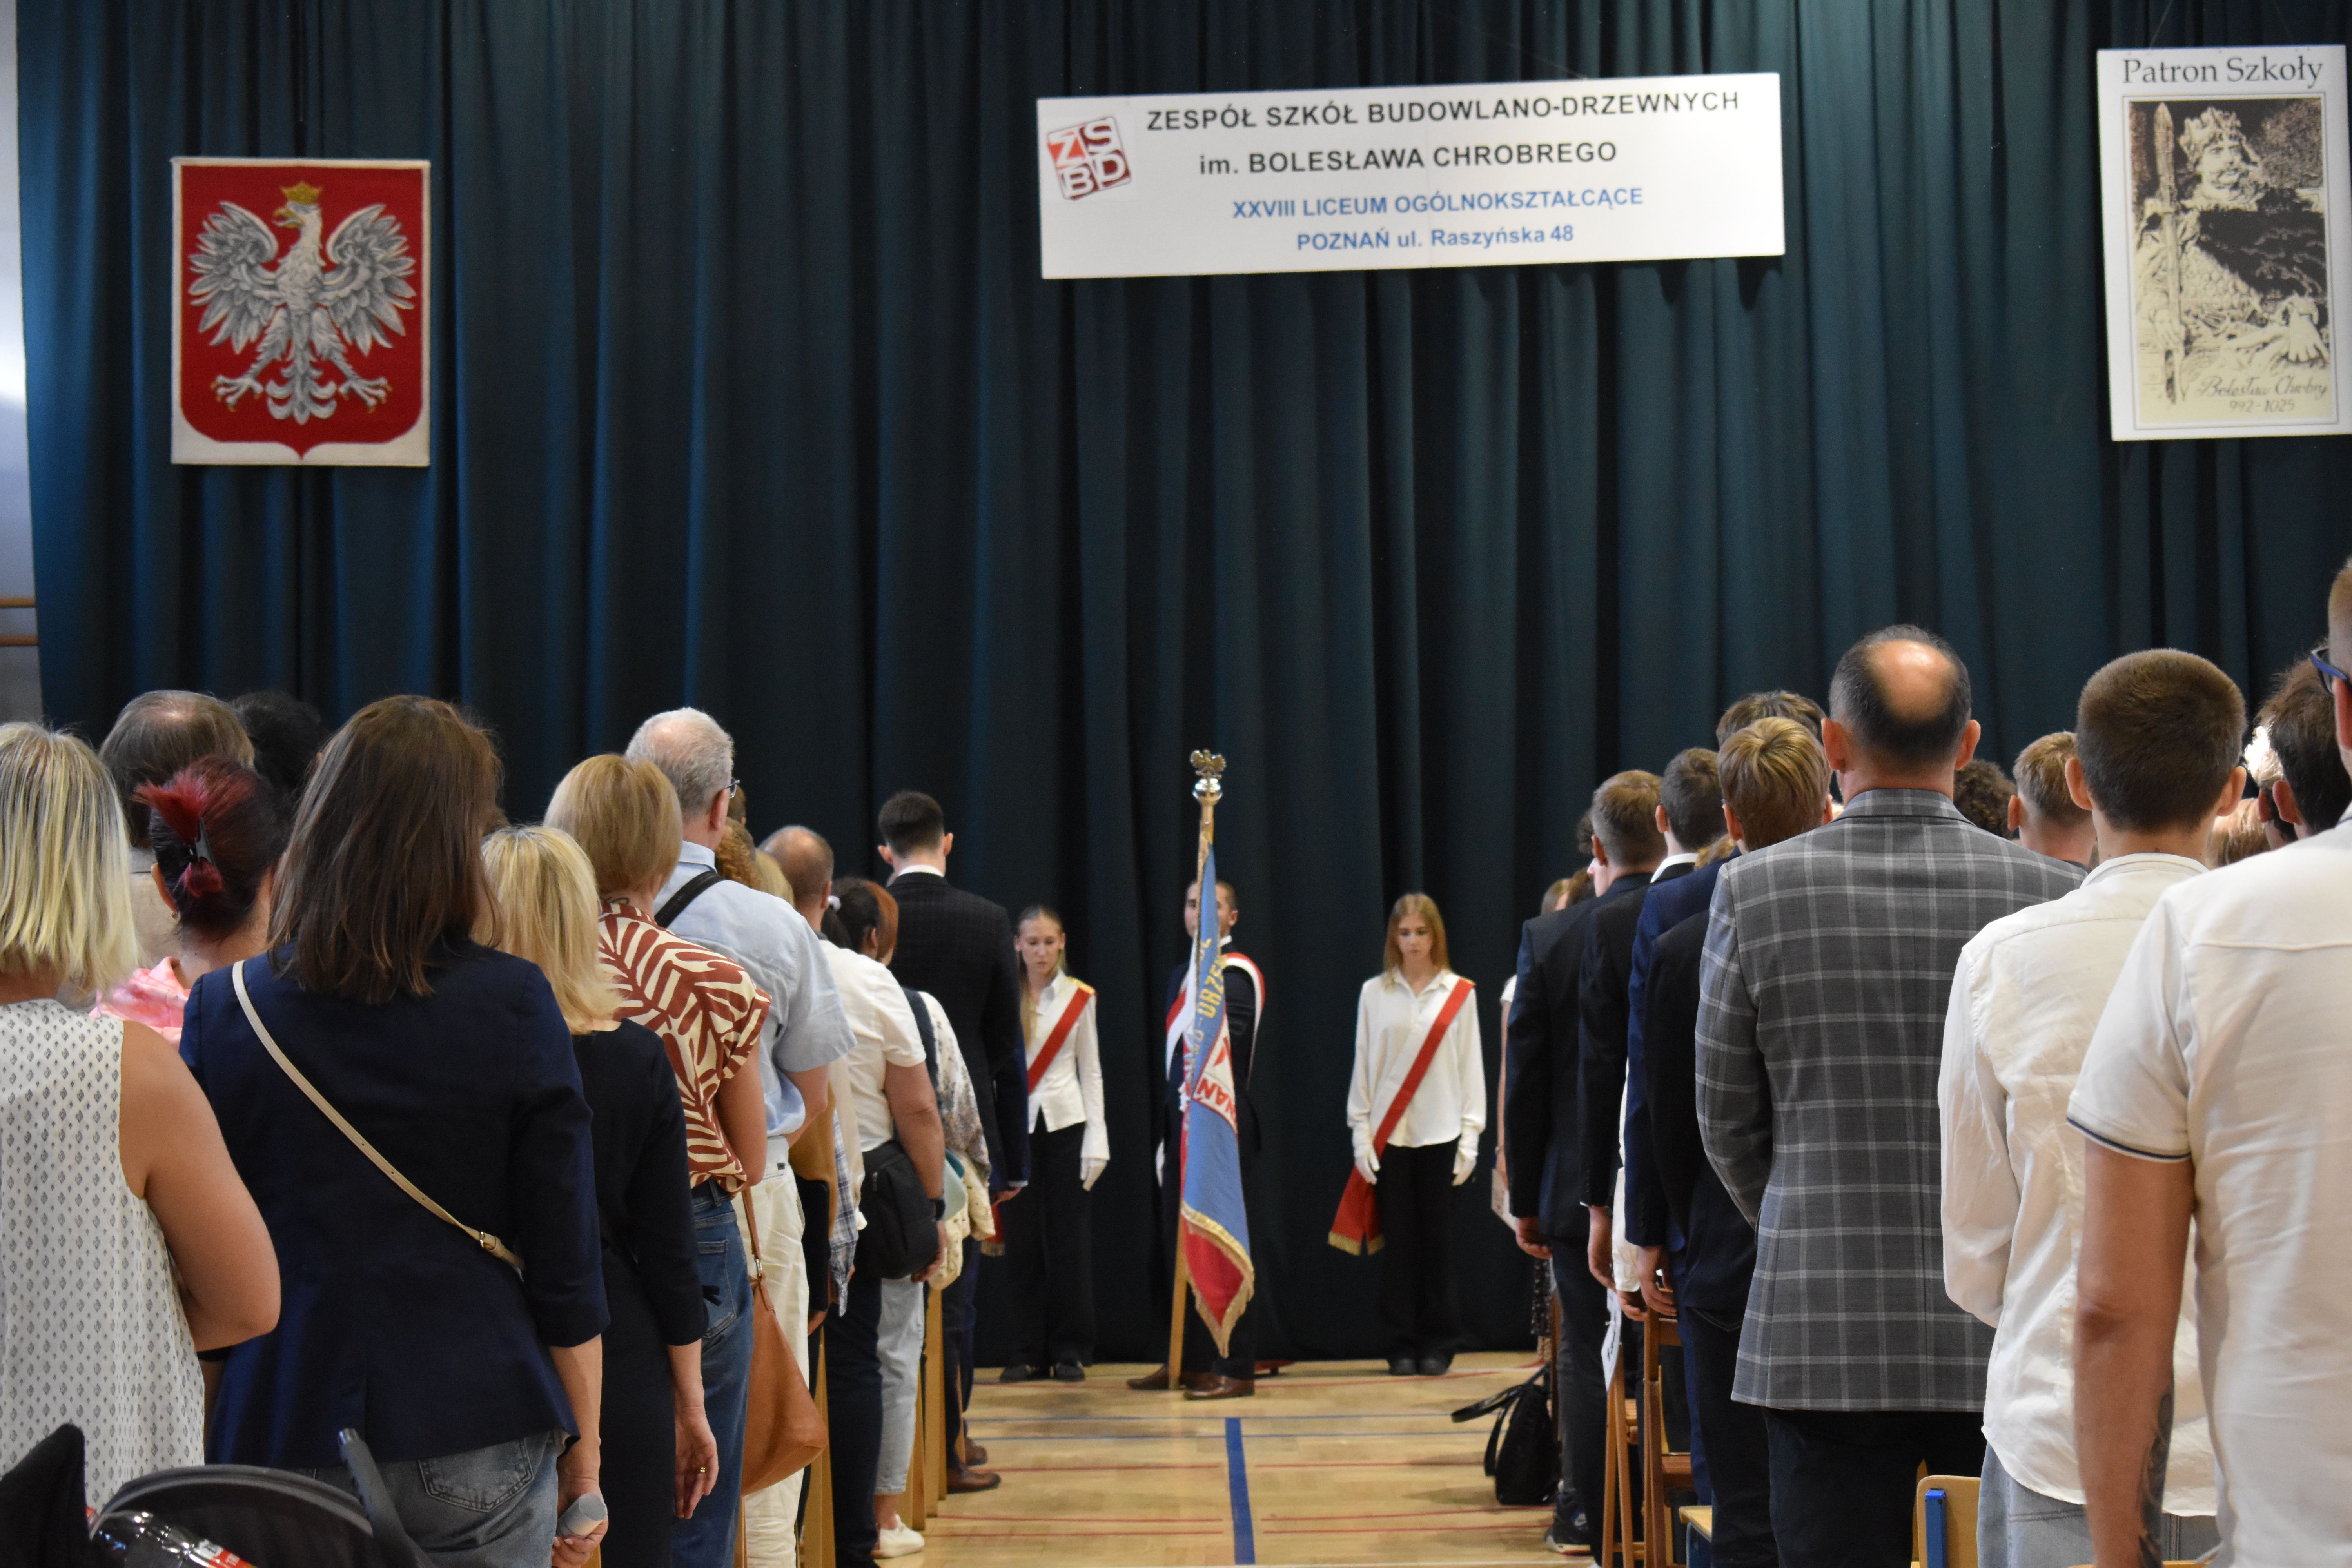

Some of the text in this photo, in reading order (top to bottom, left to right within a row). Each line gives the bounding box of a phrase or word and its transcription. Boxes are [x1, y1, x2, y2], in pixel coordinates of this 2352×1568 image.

[2122, 55, 2324, 89] Patron Szkoły
[1146, 91, 1738, 131] ZESPÓŁ SZKÓŁ BUDOWLANO-DRZEWNYCH
[1200, 141, 1617, 175] im. BOLESŁAWA CHROBREGO
[1233, 188, 1642, 219] XXVIII LICEUM OGÓLNOKSZTAŁCĄCE
[1297, 225, 1573, 251] POZNAŃ ul. Raszyńska 48
